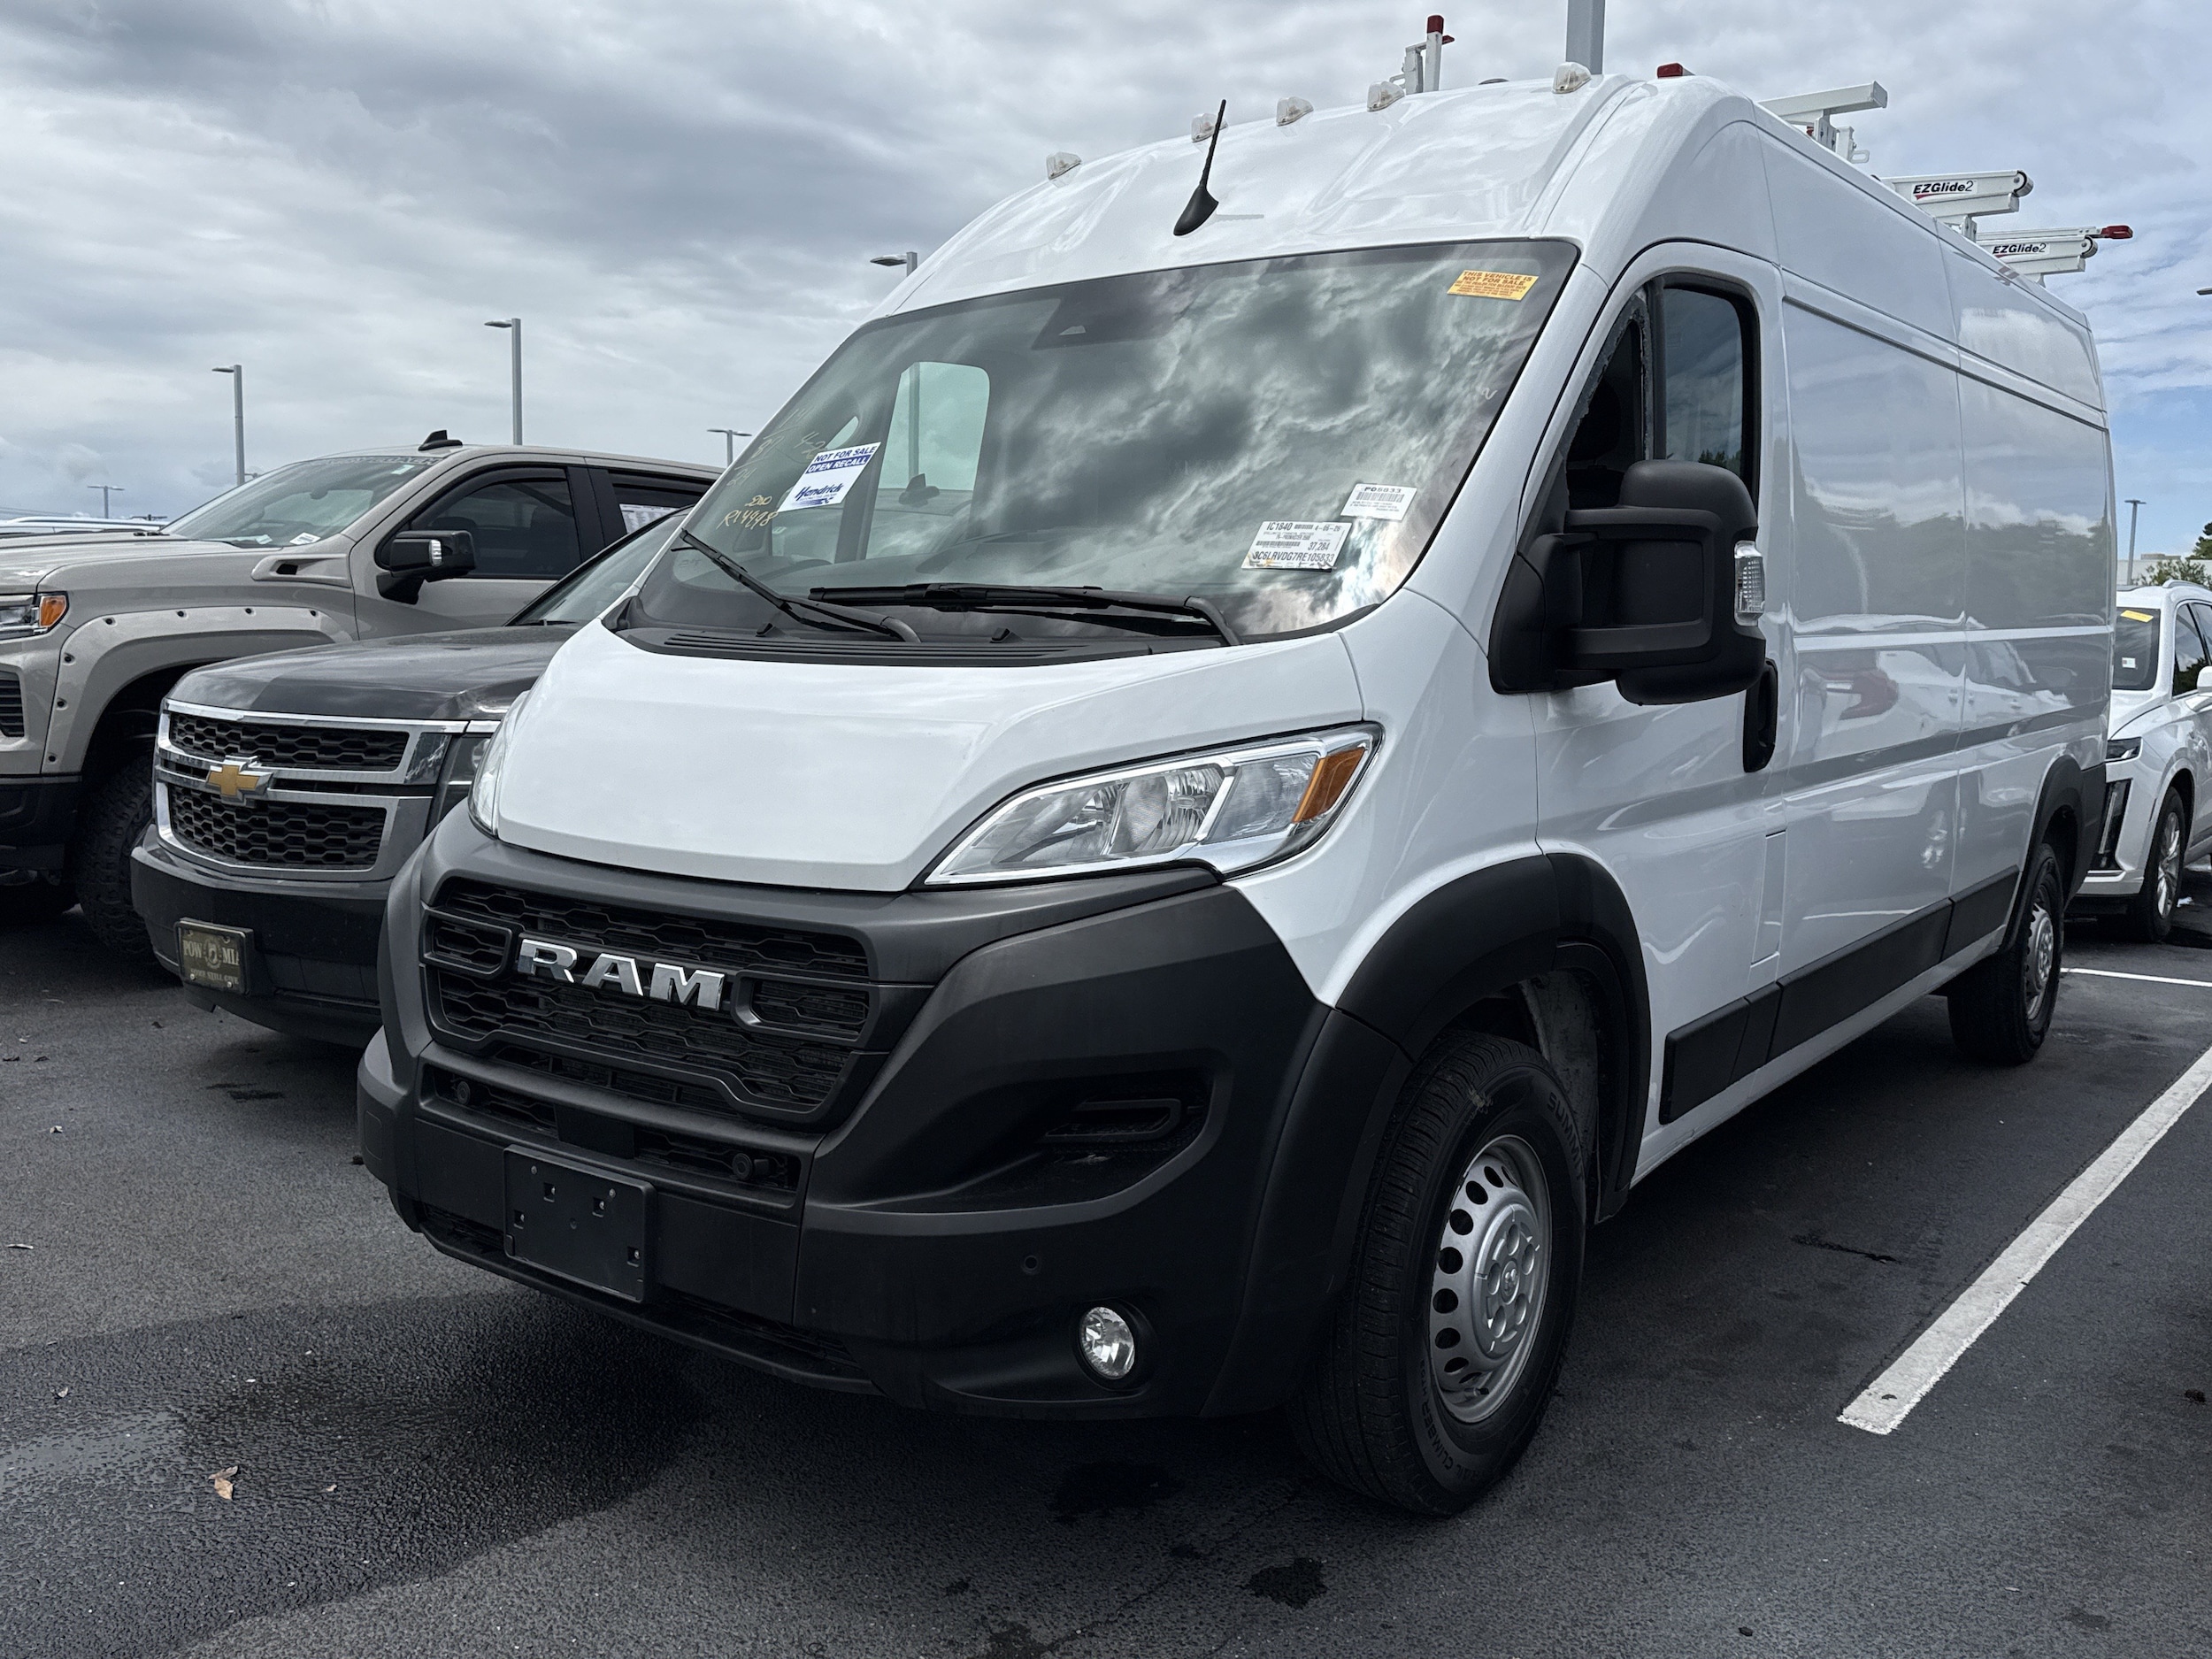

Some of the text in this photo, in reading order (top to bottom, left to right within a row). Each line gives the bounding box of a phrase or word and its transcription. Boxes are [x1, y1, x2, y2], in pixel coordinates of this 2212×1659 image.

[1912, 180, 1974, 195] EZGlide2
[1992, 242, 2047, 255] EZGlide2
[813, 446, 877, 463] NOT FOR SALE
[808, 457, 867, 472] OPEN RECALL
[794, 483, 844, 502] Hendrick
[182, 940, 203, 958] POW
[517, 939, 725, 1011] RAM
[1547, 1092, 1582, 1180] SUMMIT
[1421, 1400, 1453, 1471] CLIMBER
